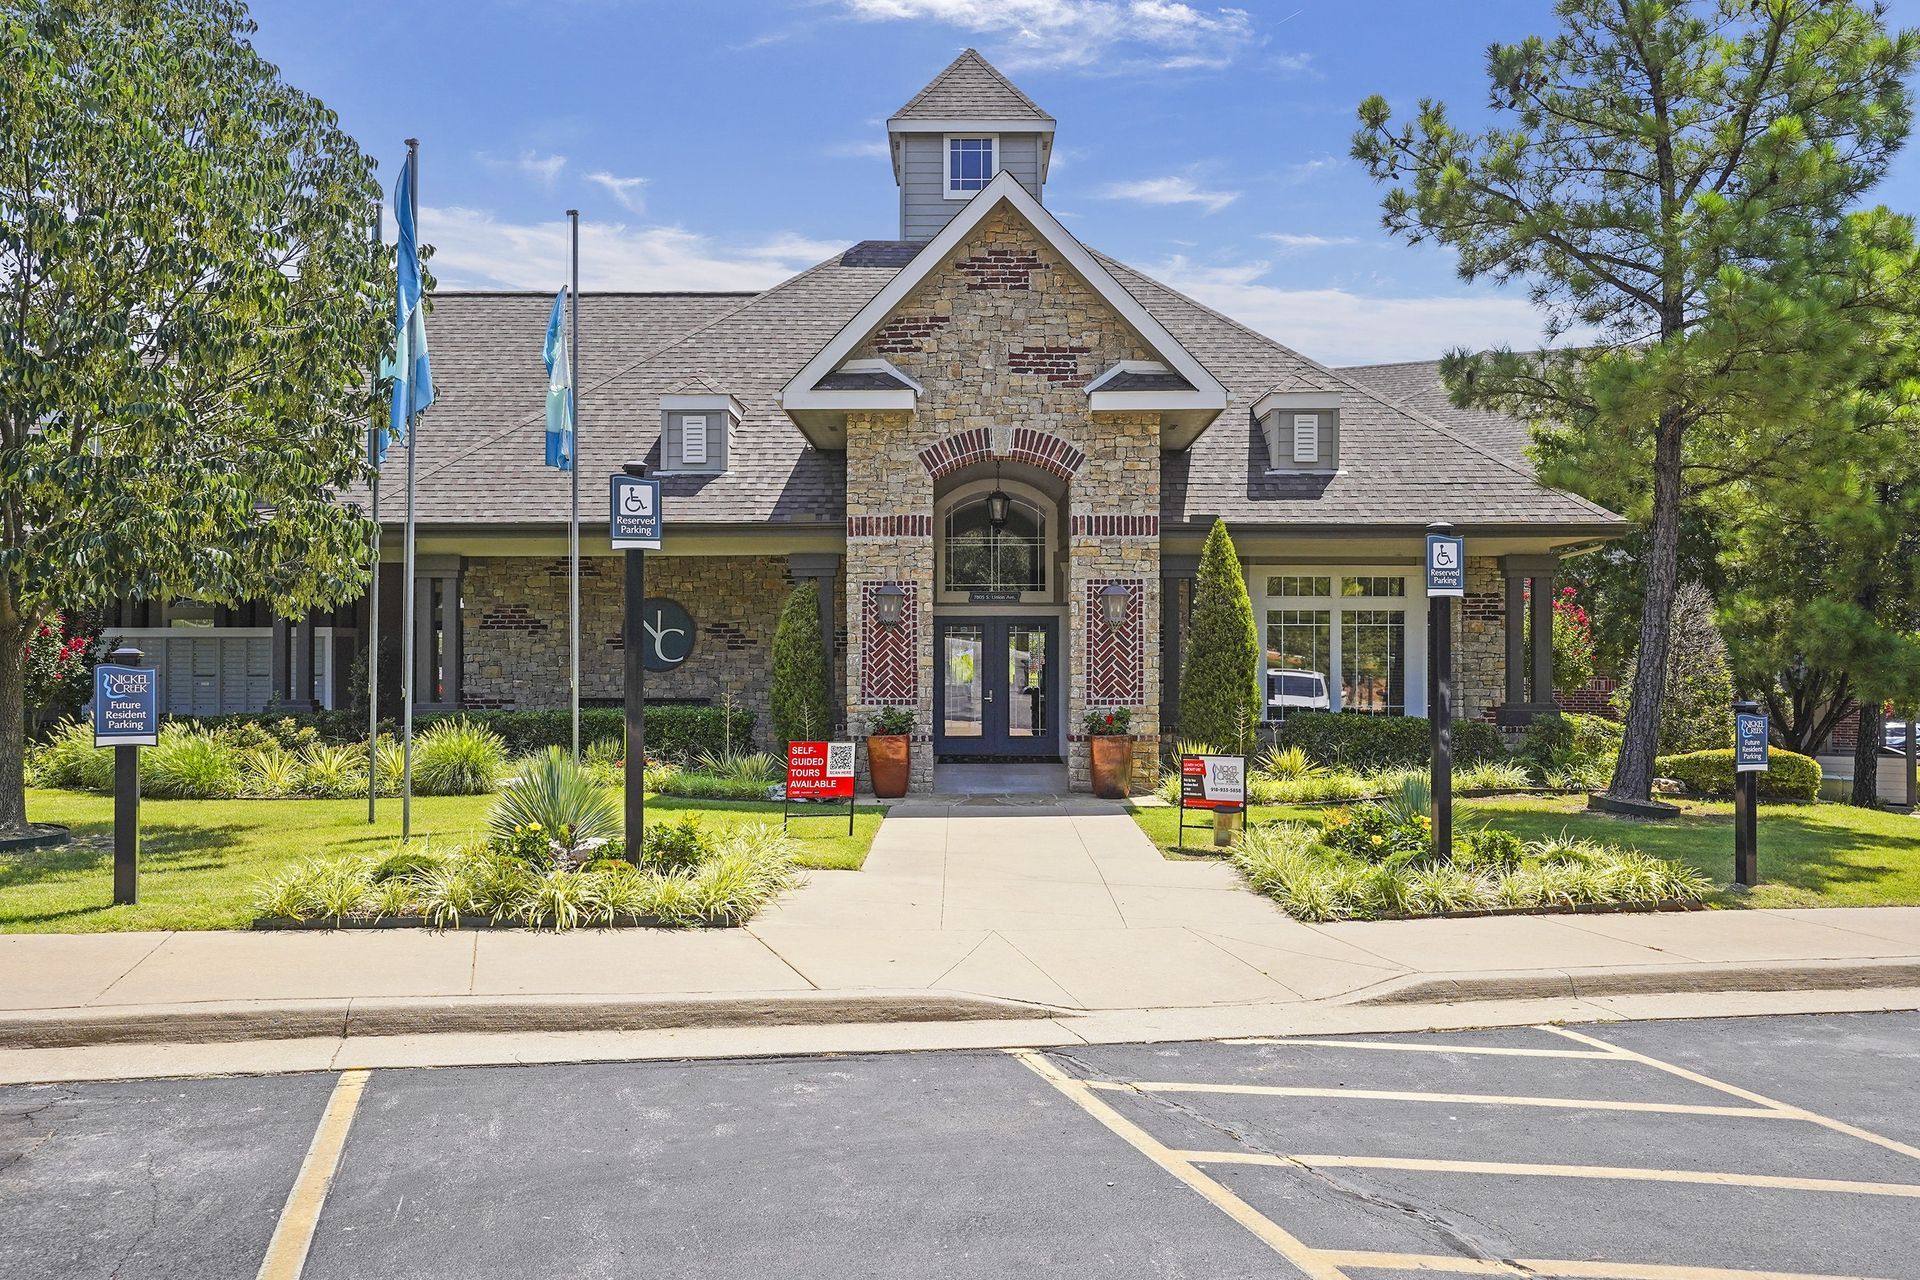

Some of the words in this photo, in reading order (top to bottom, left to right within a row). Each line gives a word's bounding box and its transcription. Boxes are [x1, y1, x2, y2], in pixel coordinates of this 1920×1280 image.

[616, 516, 656, 524] Reserved
[620, 525, 652, 536] Parking
[1434, 576, 1456, 586] Parking
[110, 674, 150, 684] NICKEL
[113, 683, 148, 694] CREEK
[111, 701, 141, 709] Future
[106, 710, 146, 718] Resident
[108, 720, 144, 730] Parking
[792, 746, 816, 754] SELF-
